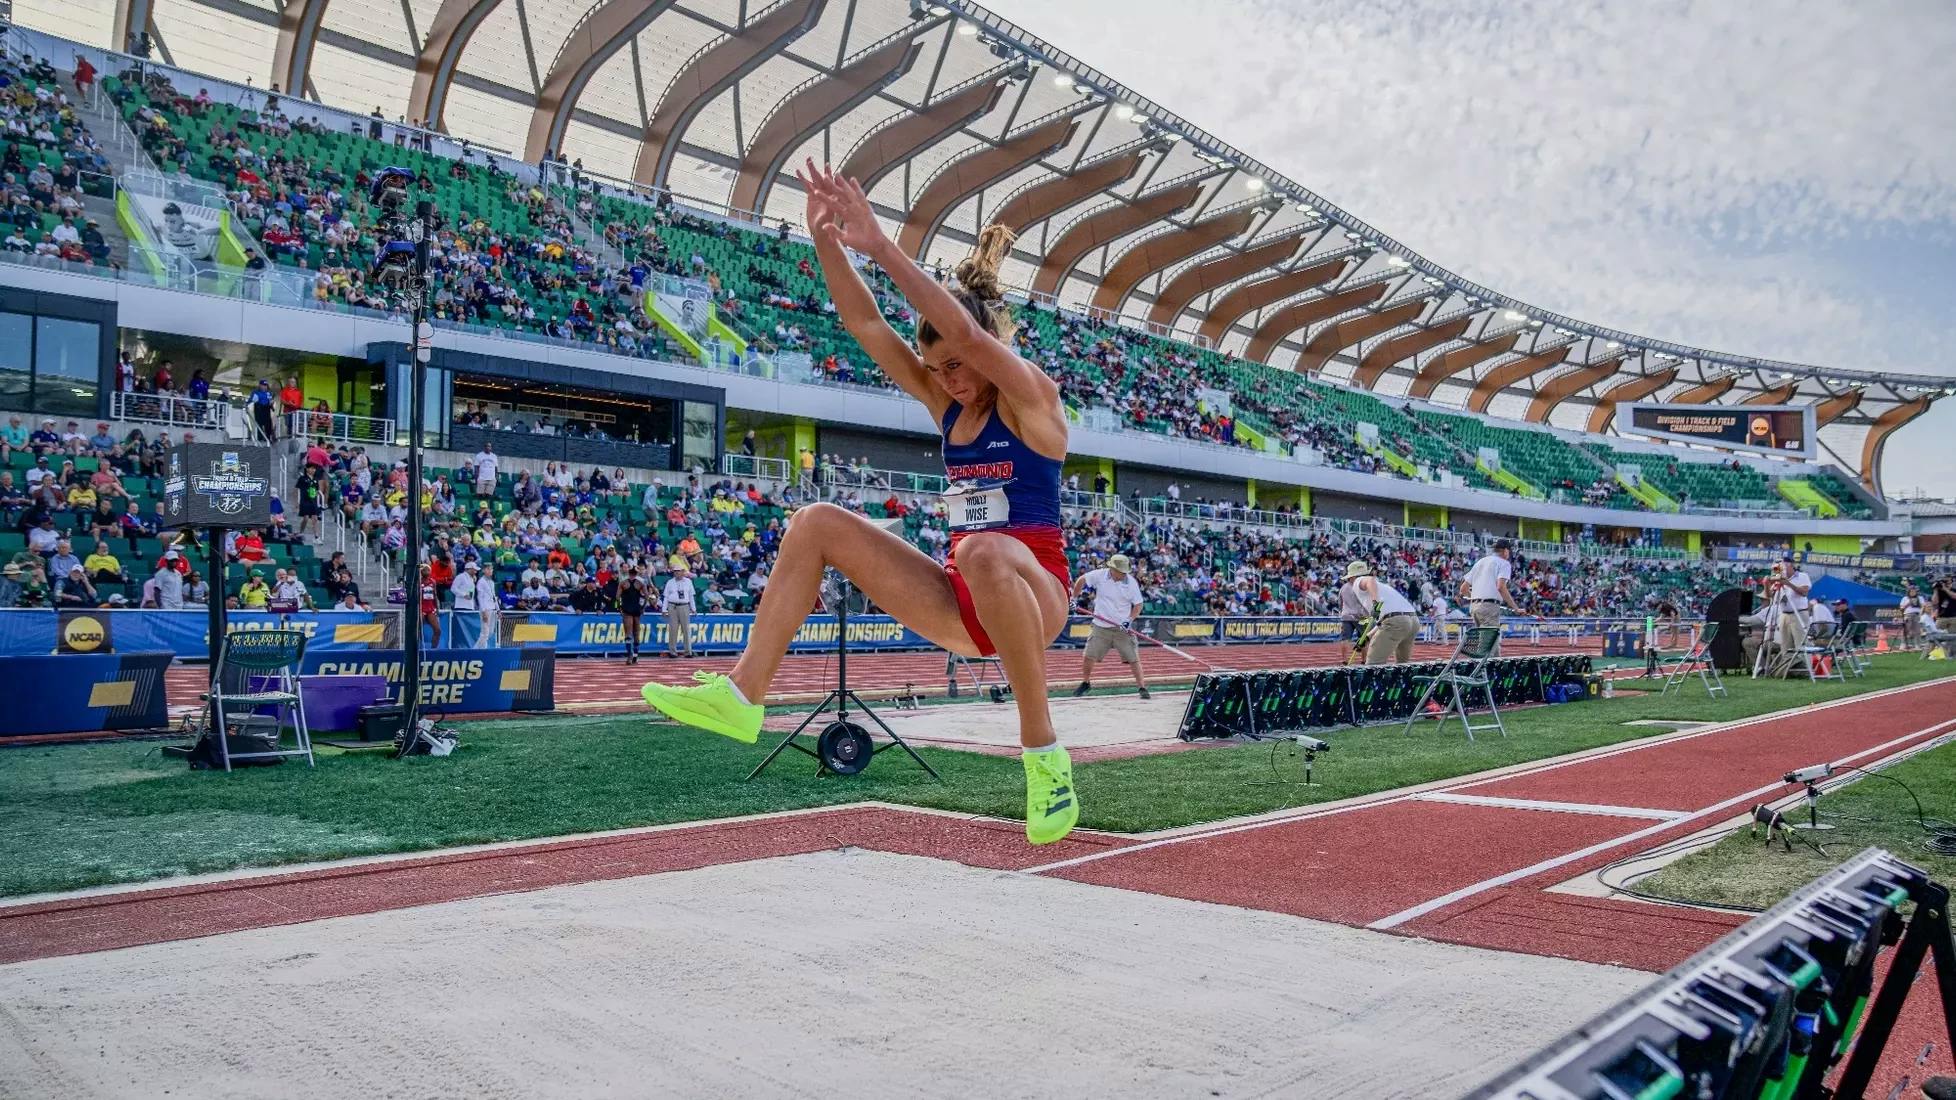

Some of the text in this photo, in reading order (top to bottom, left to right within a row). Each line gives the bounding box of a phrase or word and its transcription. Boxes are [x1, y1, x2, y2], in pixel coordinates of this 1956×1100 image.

[1657, 416, 1685, 424] DIVISION
[1690, 417, 1711, 425] TRACK
[1717, 417, 1736, 426] FIELD
[1670, 425, 1723, 433] CHAMPIONSHIPS
[198, 480, 262, 492] CHAMPIONSHIPS
[965, 495, 987, 506] MOLLY
[965, 507, 989, 521] WISE
[1807, 552, 1849, 567] UNIVERSITY
[1850, 557, 1861, 567] OF
[1862, 557, 1894, 569] OREGON
[580, 623, 626, 644] NCAA
[711, 623, 744, 644] AND
[792, 623, 904, 643] CHAMPONSHIPS
[1225, 622, 1247, 636] NCAA
[1256, 622, 1279, 636] TRACK
[1279, 622, 1293, 636] AND
[1294, 622, 1312, 636] FIELD
[69, 632, 101, 643] NCAA
[318, 660, 484, 683] CHAMIONS
